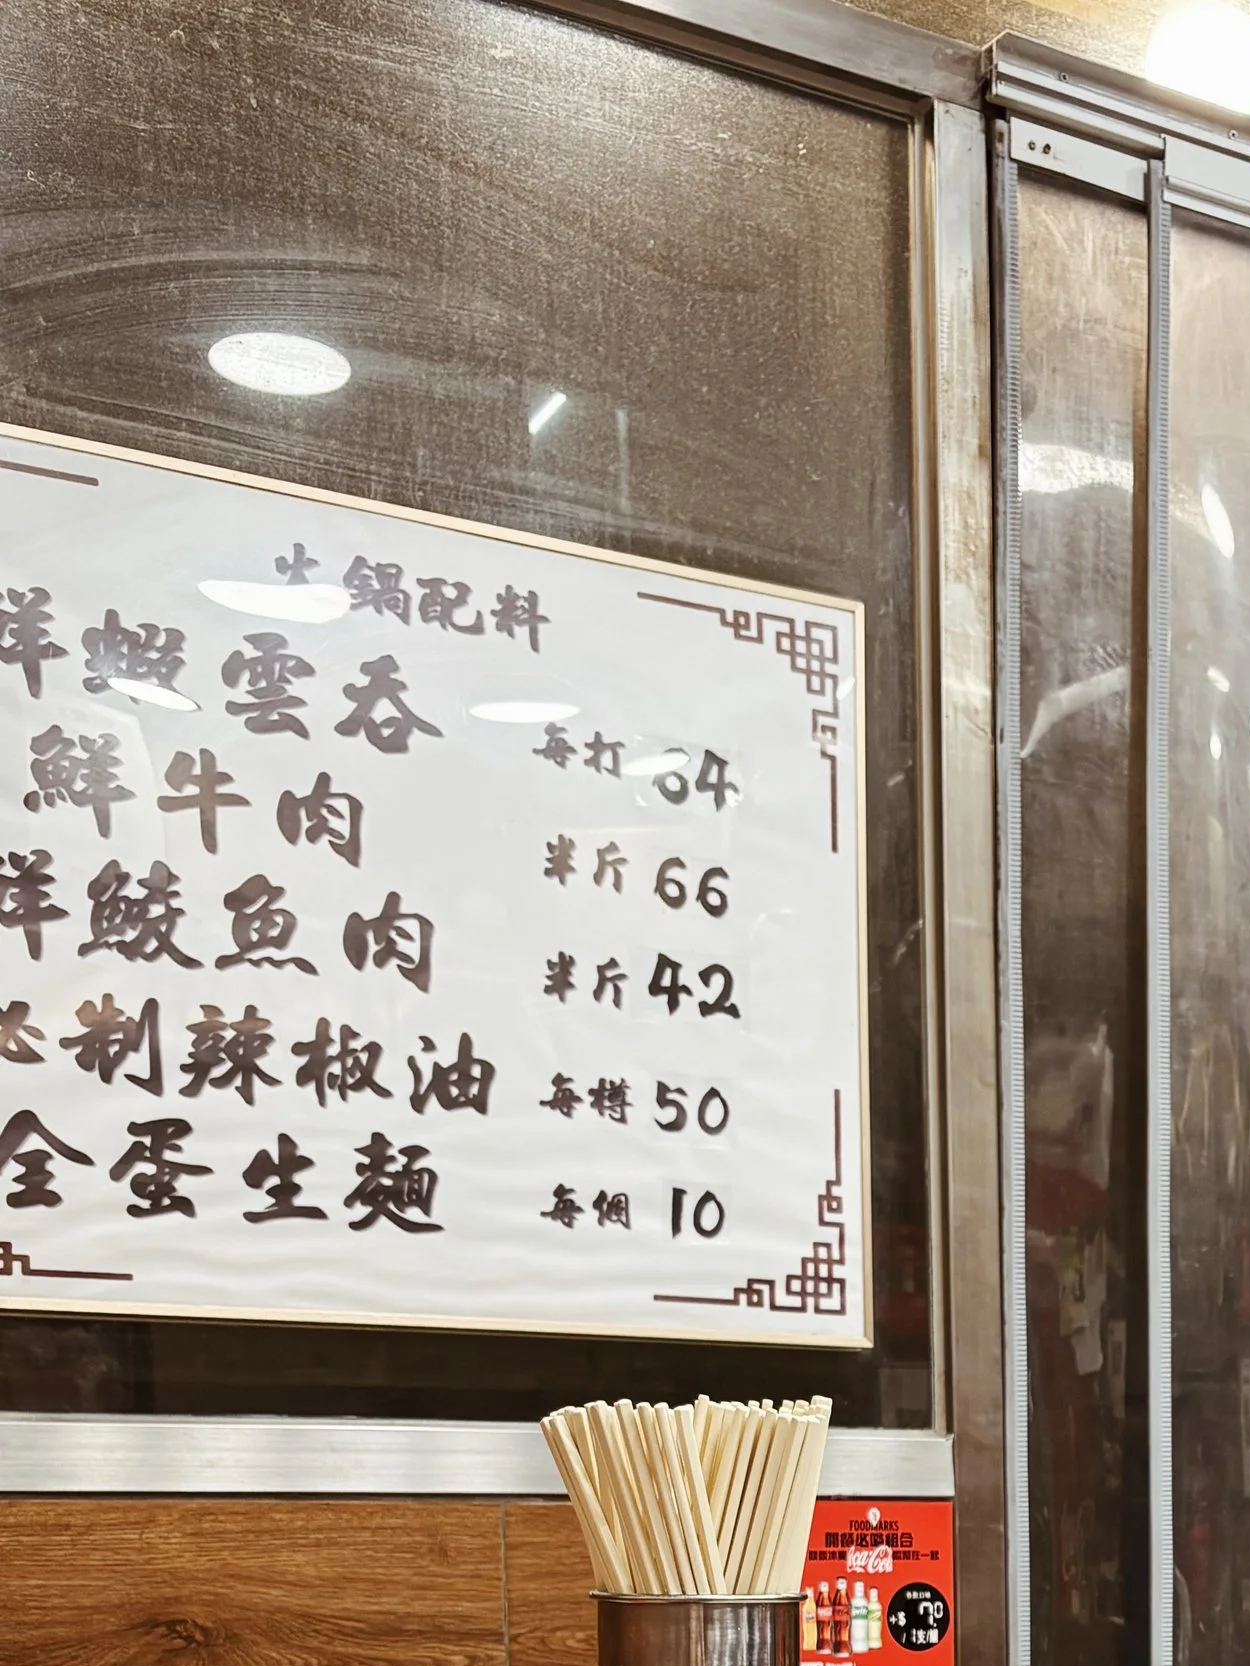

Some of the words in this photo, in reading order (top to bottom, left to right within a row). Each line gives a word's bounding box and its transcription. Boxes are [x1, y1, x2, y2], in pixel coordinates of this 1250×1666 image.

[532, 721, 627, 780] 每打
[23, 724, 364, 868] 鮮牛肉
[543, 833, 629, 894] 半斤
[653, 856, 730, 918] 66
[543, 951, 629, 1010] 半斤
[647, 952, 741, 1019] 42
[654, 1080, 730, 1136] 50
[670, 1186, 726, 1240] 10
